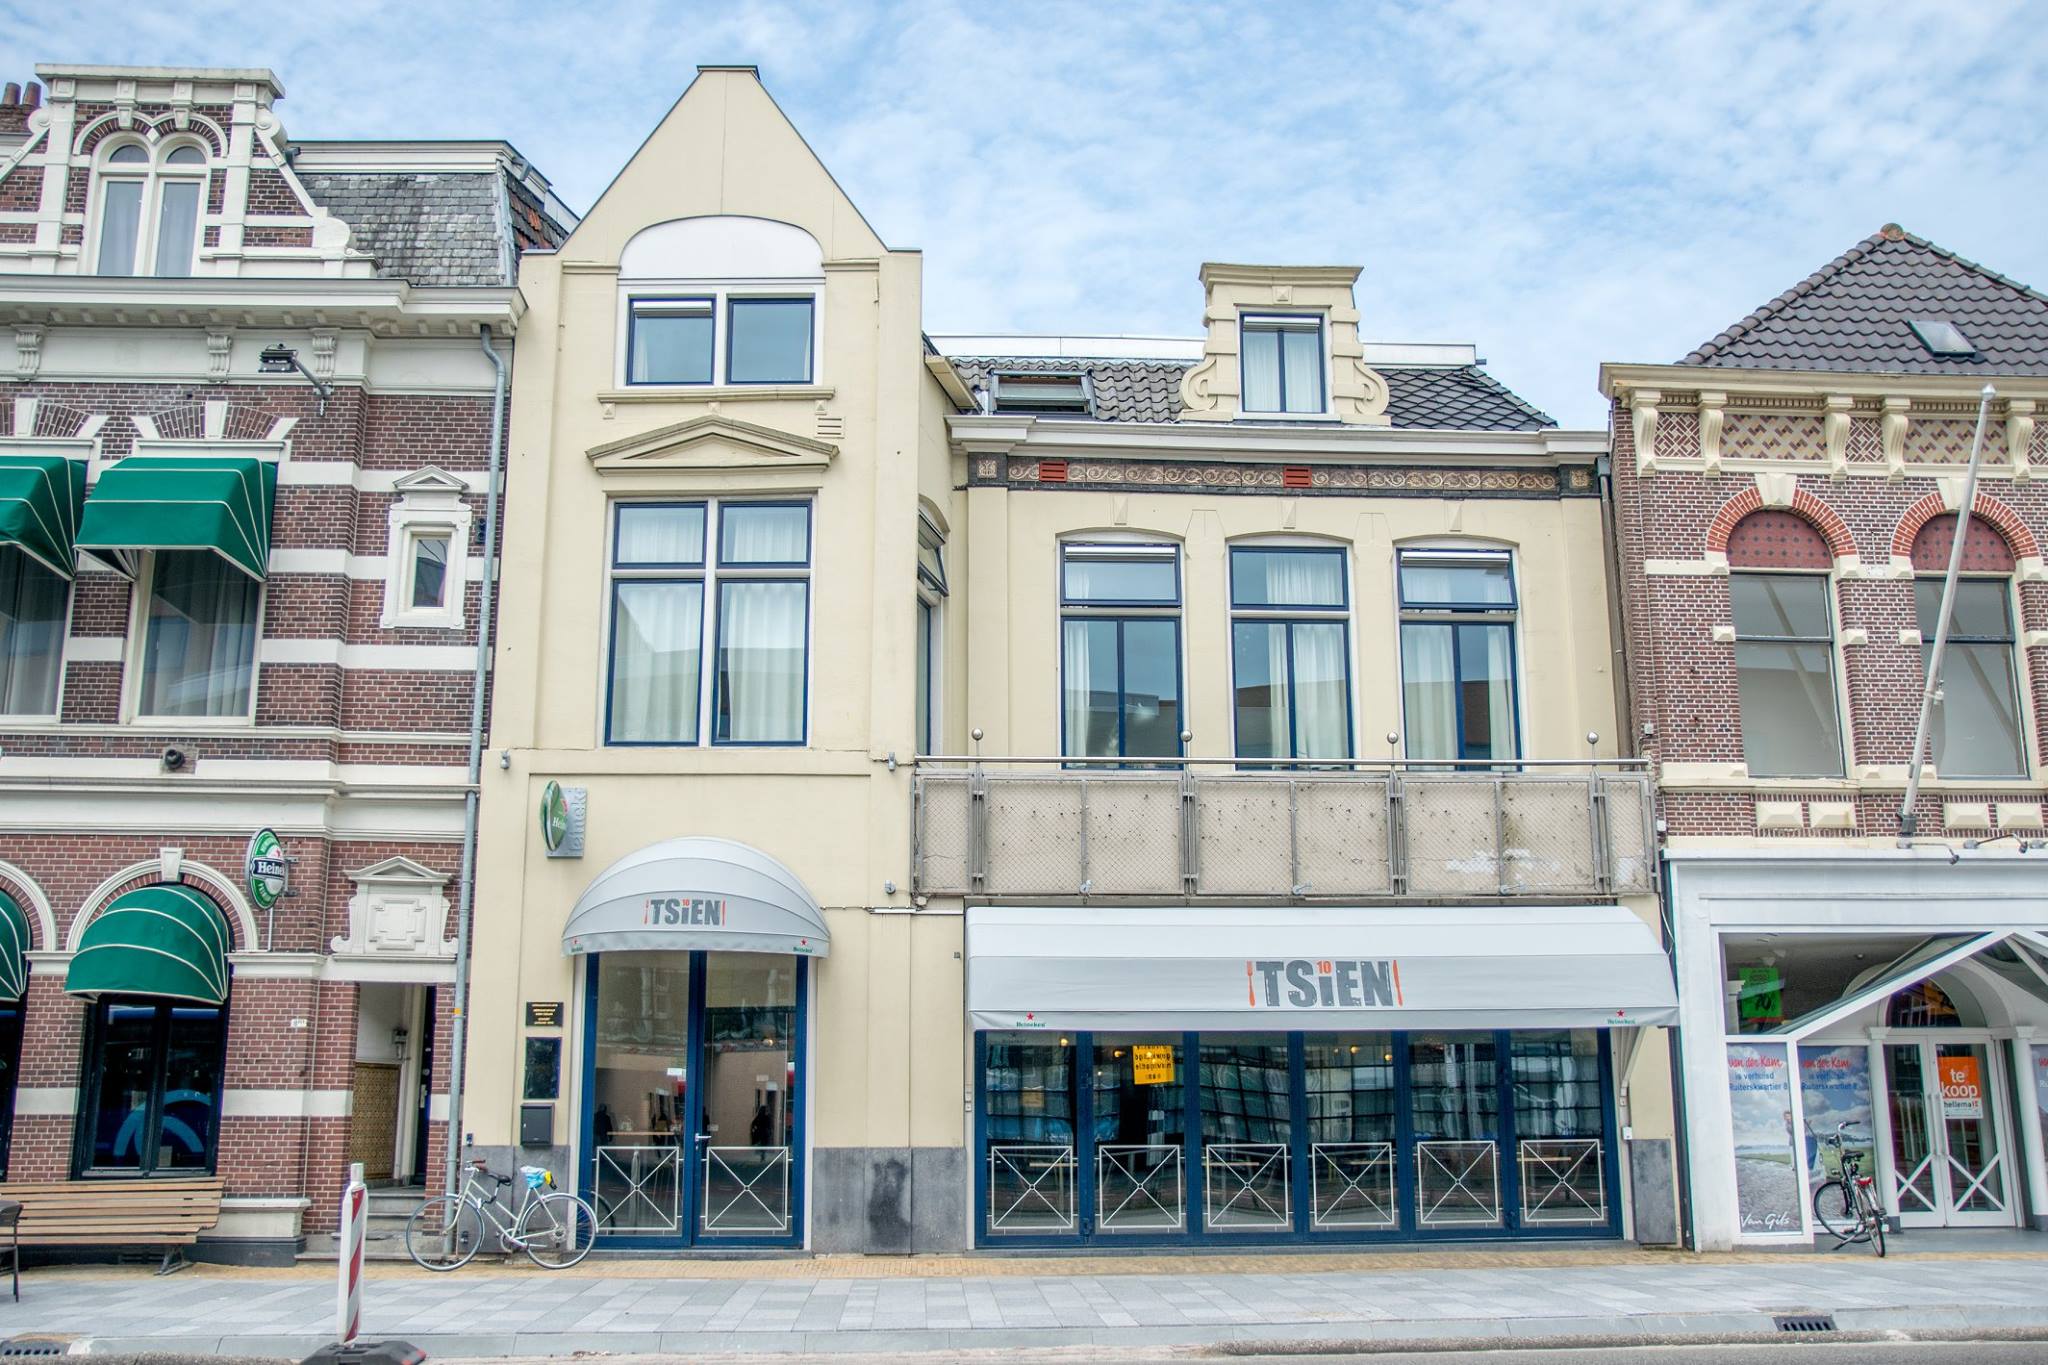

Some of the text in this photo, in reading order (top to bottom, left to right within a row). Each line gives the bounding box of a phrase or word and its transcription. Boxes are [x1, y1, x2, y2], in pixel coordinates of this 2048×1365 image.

[1950, 1069, 1965, 1083] te
[1942, 1082, 1978, 1099] koop
[1740, 1213, 1763, 1228] Van
